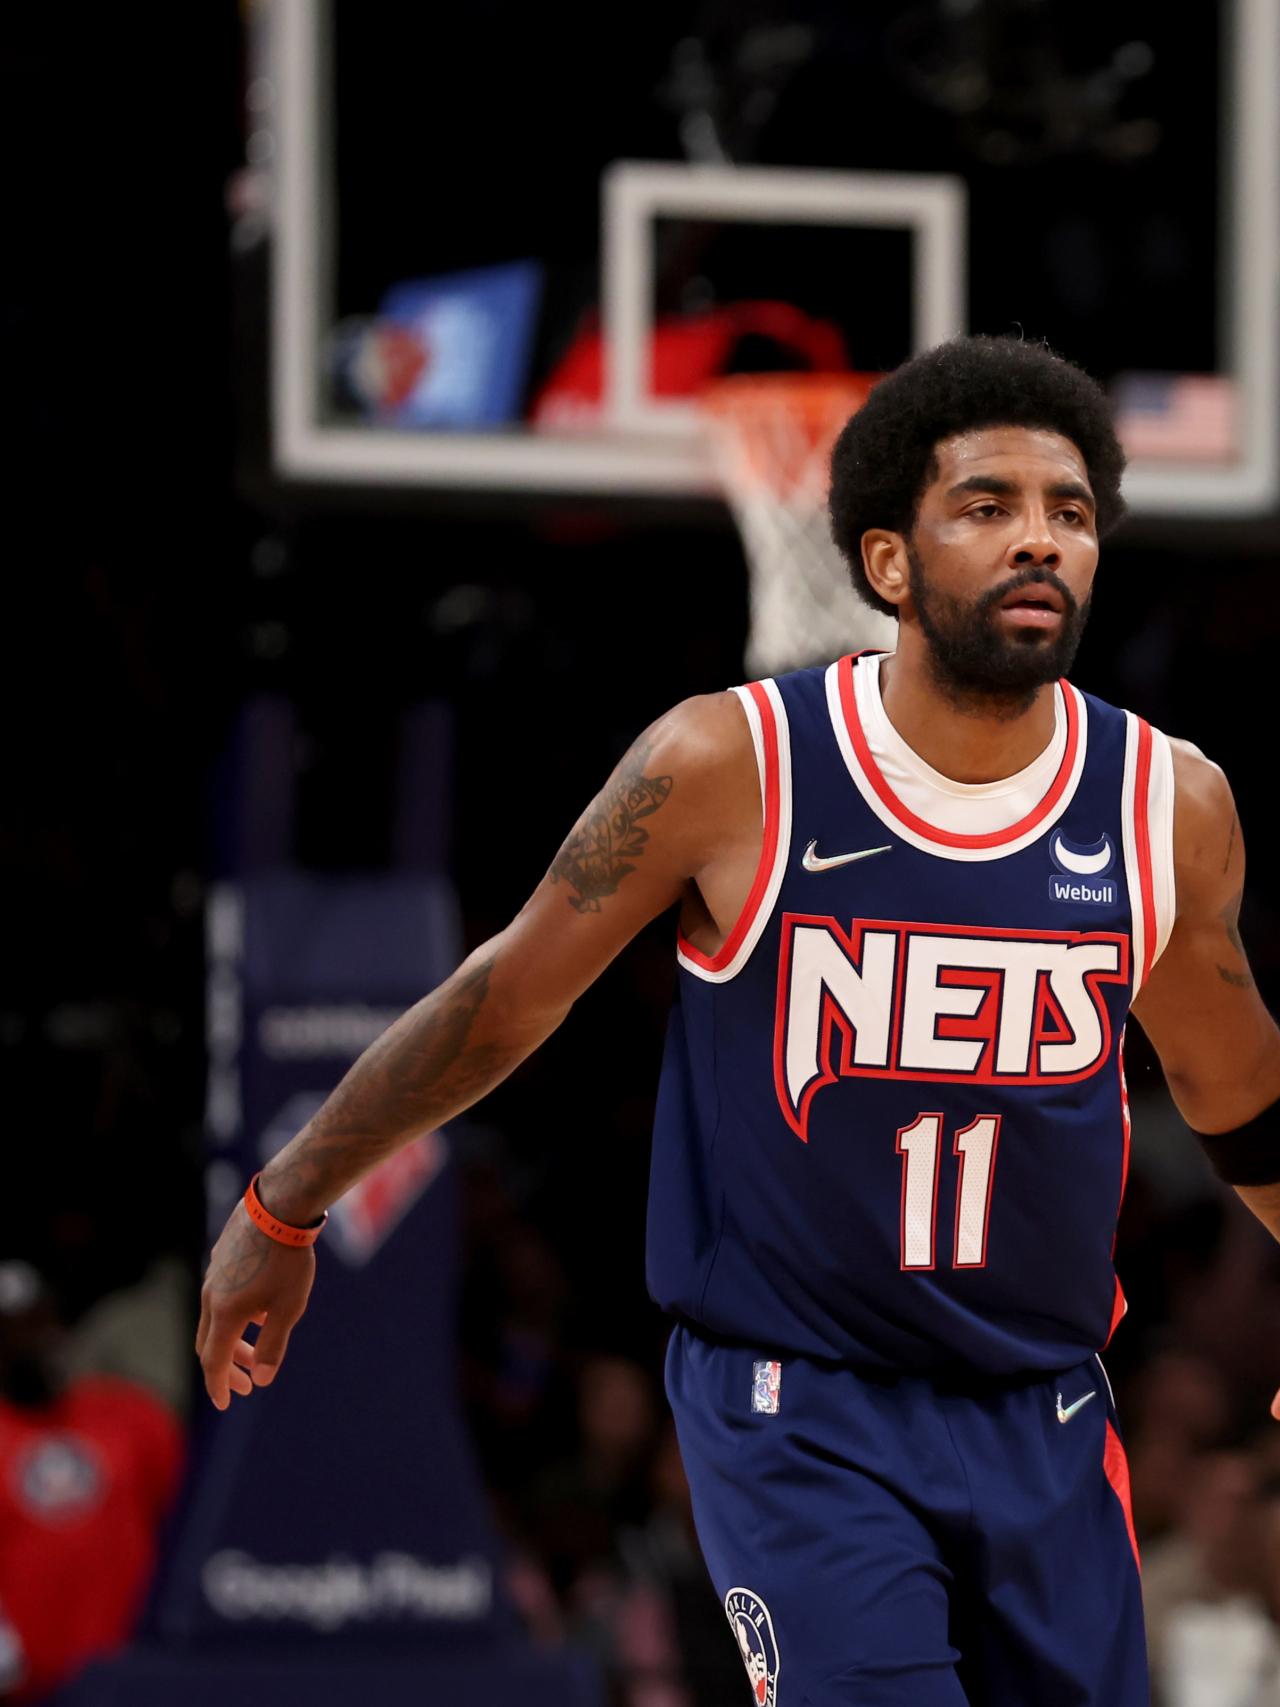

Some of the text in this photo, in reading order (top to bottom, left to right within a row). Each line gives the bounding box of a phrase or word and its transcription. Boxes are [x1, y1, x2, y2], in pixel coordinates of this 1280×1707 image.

[1054, 882, 1112, 903] Webull
[774, 912, 1130, 1144] NETS
[896, 1112, 1002, 1271] 11
